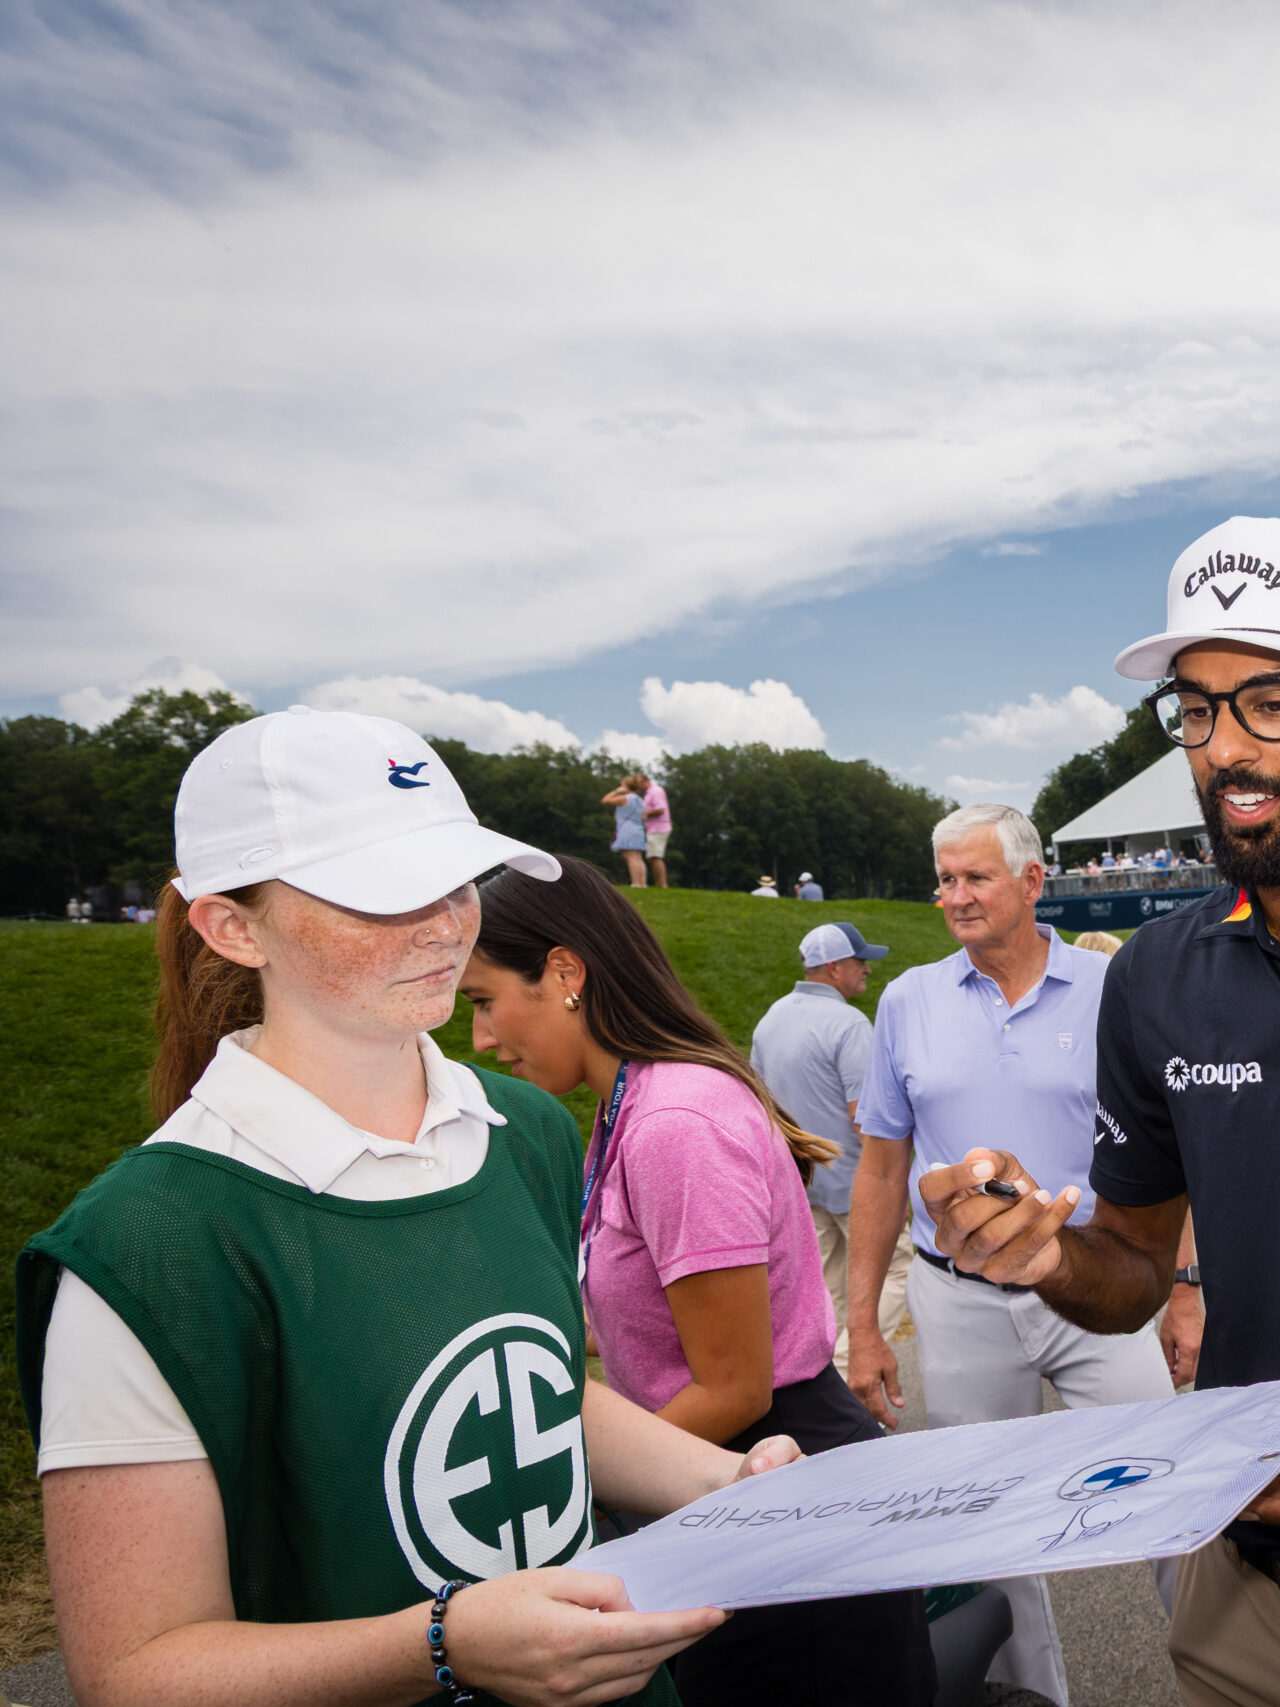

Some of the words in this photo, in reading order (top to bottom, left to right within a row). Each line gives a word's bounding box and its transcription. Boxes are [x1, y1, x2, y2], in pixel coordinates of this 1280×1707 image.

[1191, 1062, 1263, 1092] coupa
[613, 1082, 626, 1105] TOUR
[679, 1476, 1025, 1529] CHAMPIONSHIP
[869, 1496, 1000, 1527] BMW
